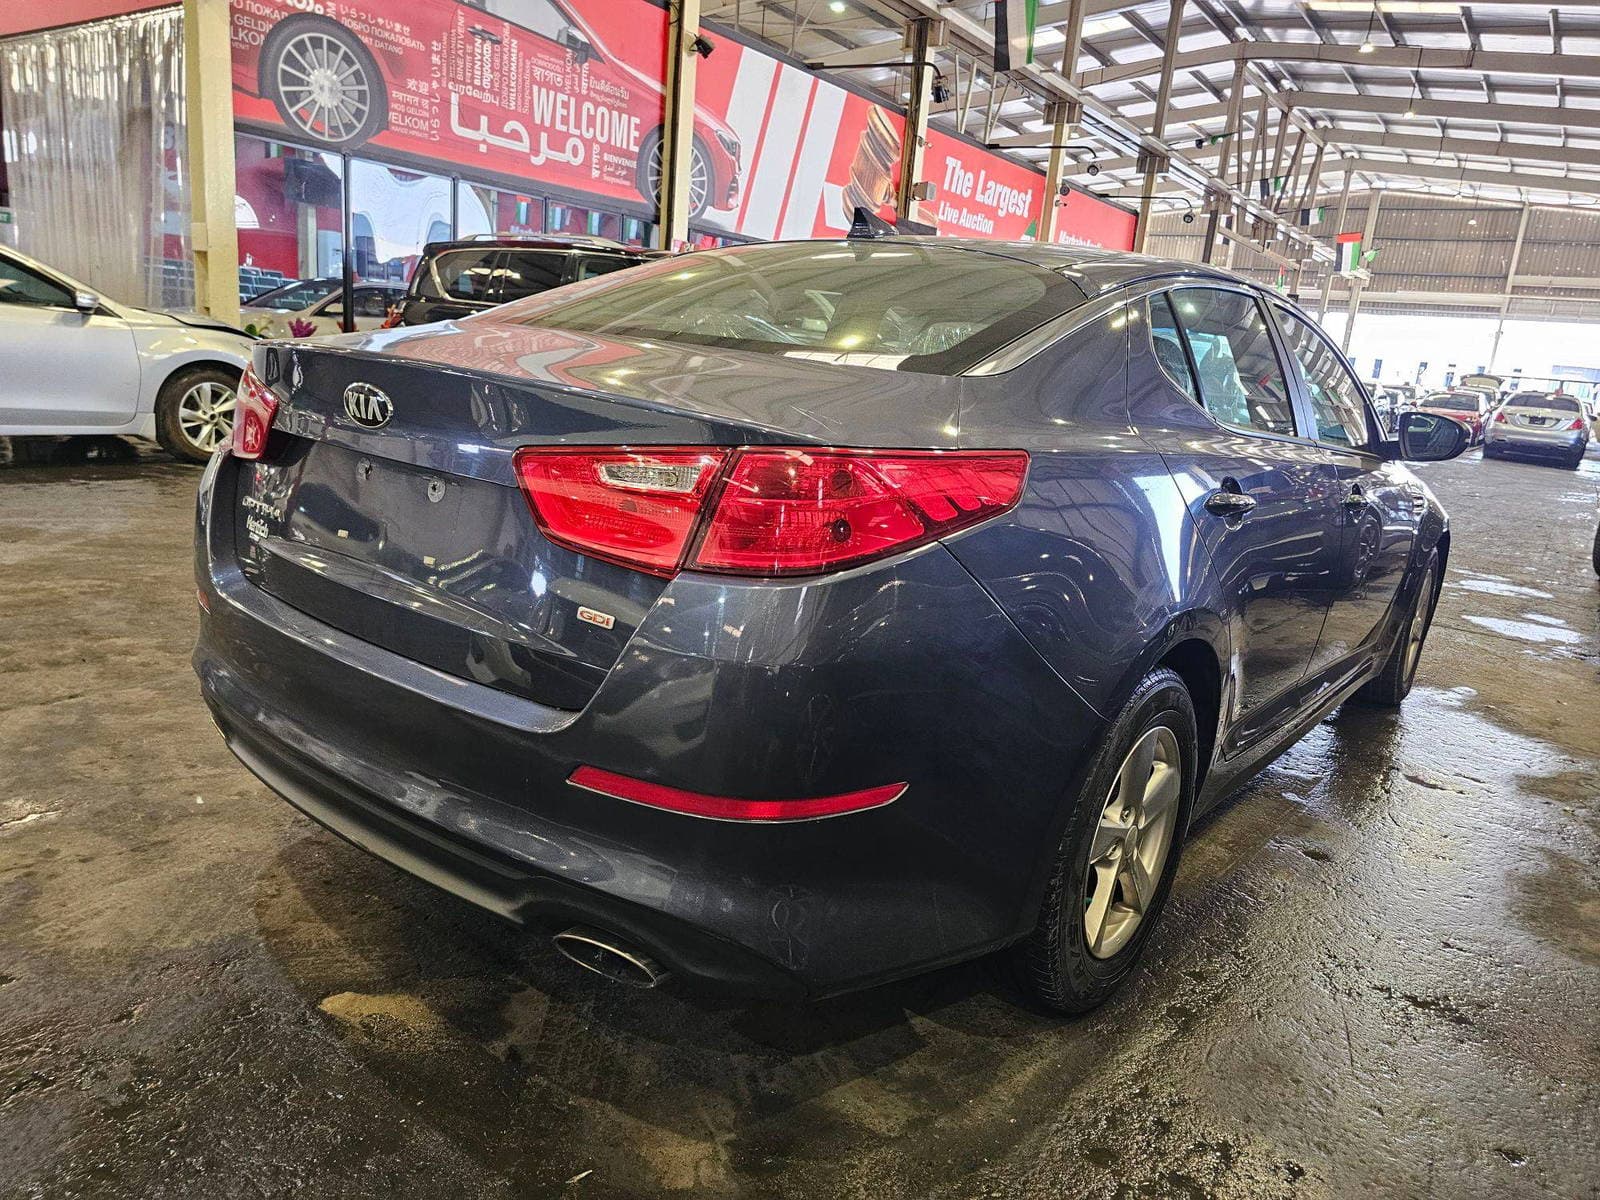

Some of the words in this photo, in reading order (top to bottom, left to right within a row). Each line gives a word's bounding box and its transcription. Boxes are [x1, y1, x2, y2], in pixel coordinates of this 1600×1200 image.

[509, 39, 518, 110] WILLKOMMEN
[450, 92, 585, 166] مرحبا
[532, 84, 640, 153] WELCOME
[938, 200, 959, 224] Live
[959, 207, 994, 235] Auction
[943, 155, 974, 198] The
[975, 169, 1033, 218] Largest
[347, 390, 384, 422] KIA
[580, 609, 611, 626] GDI
